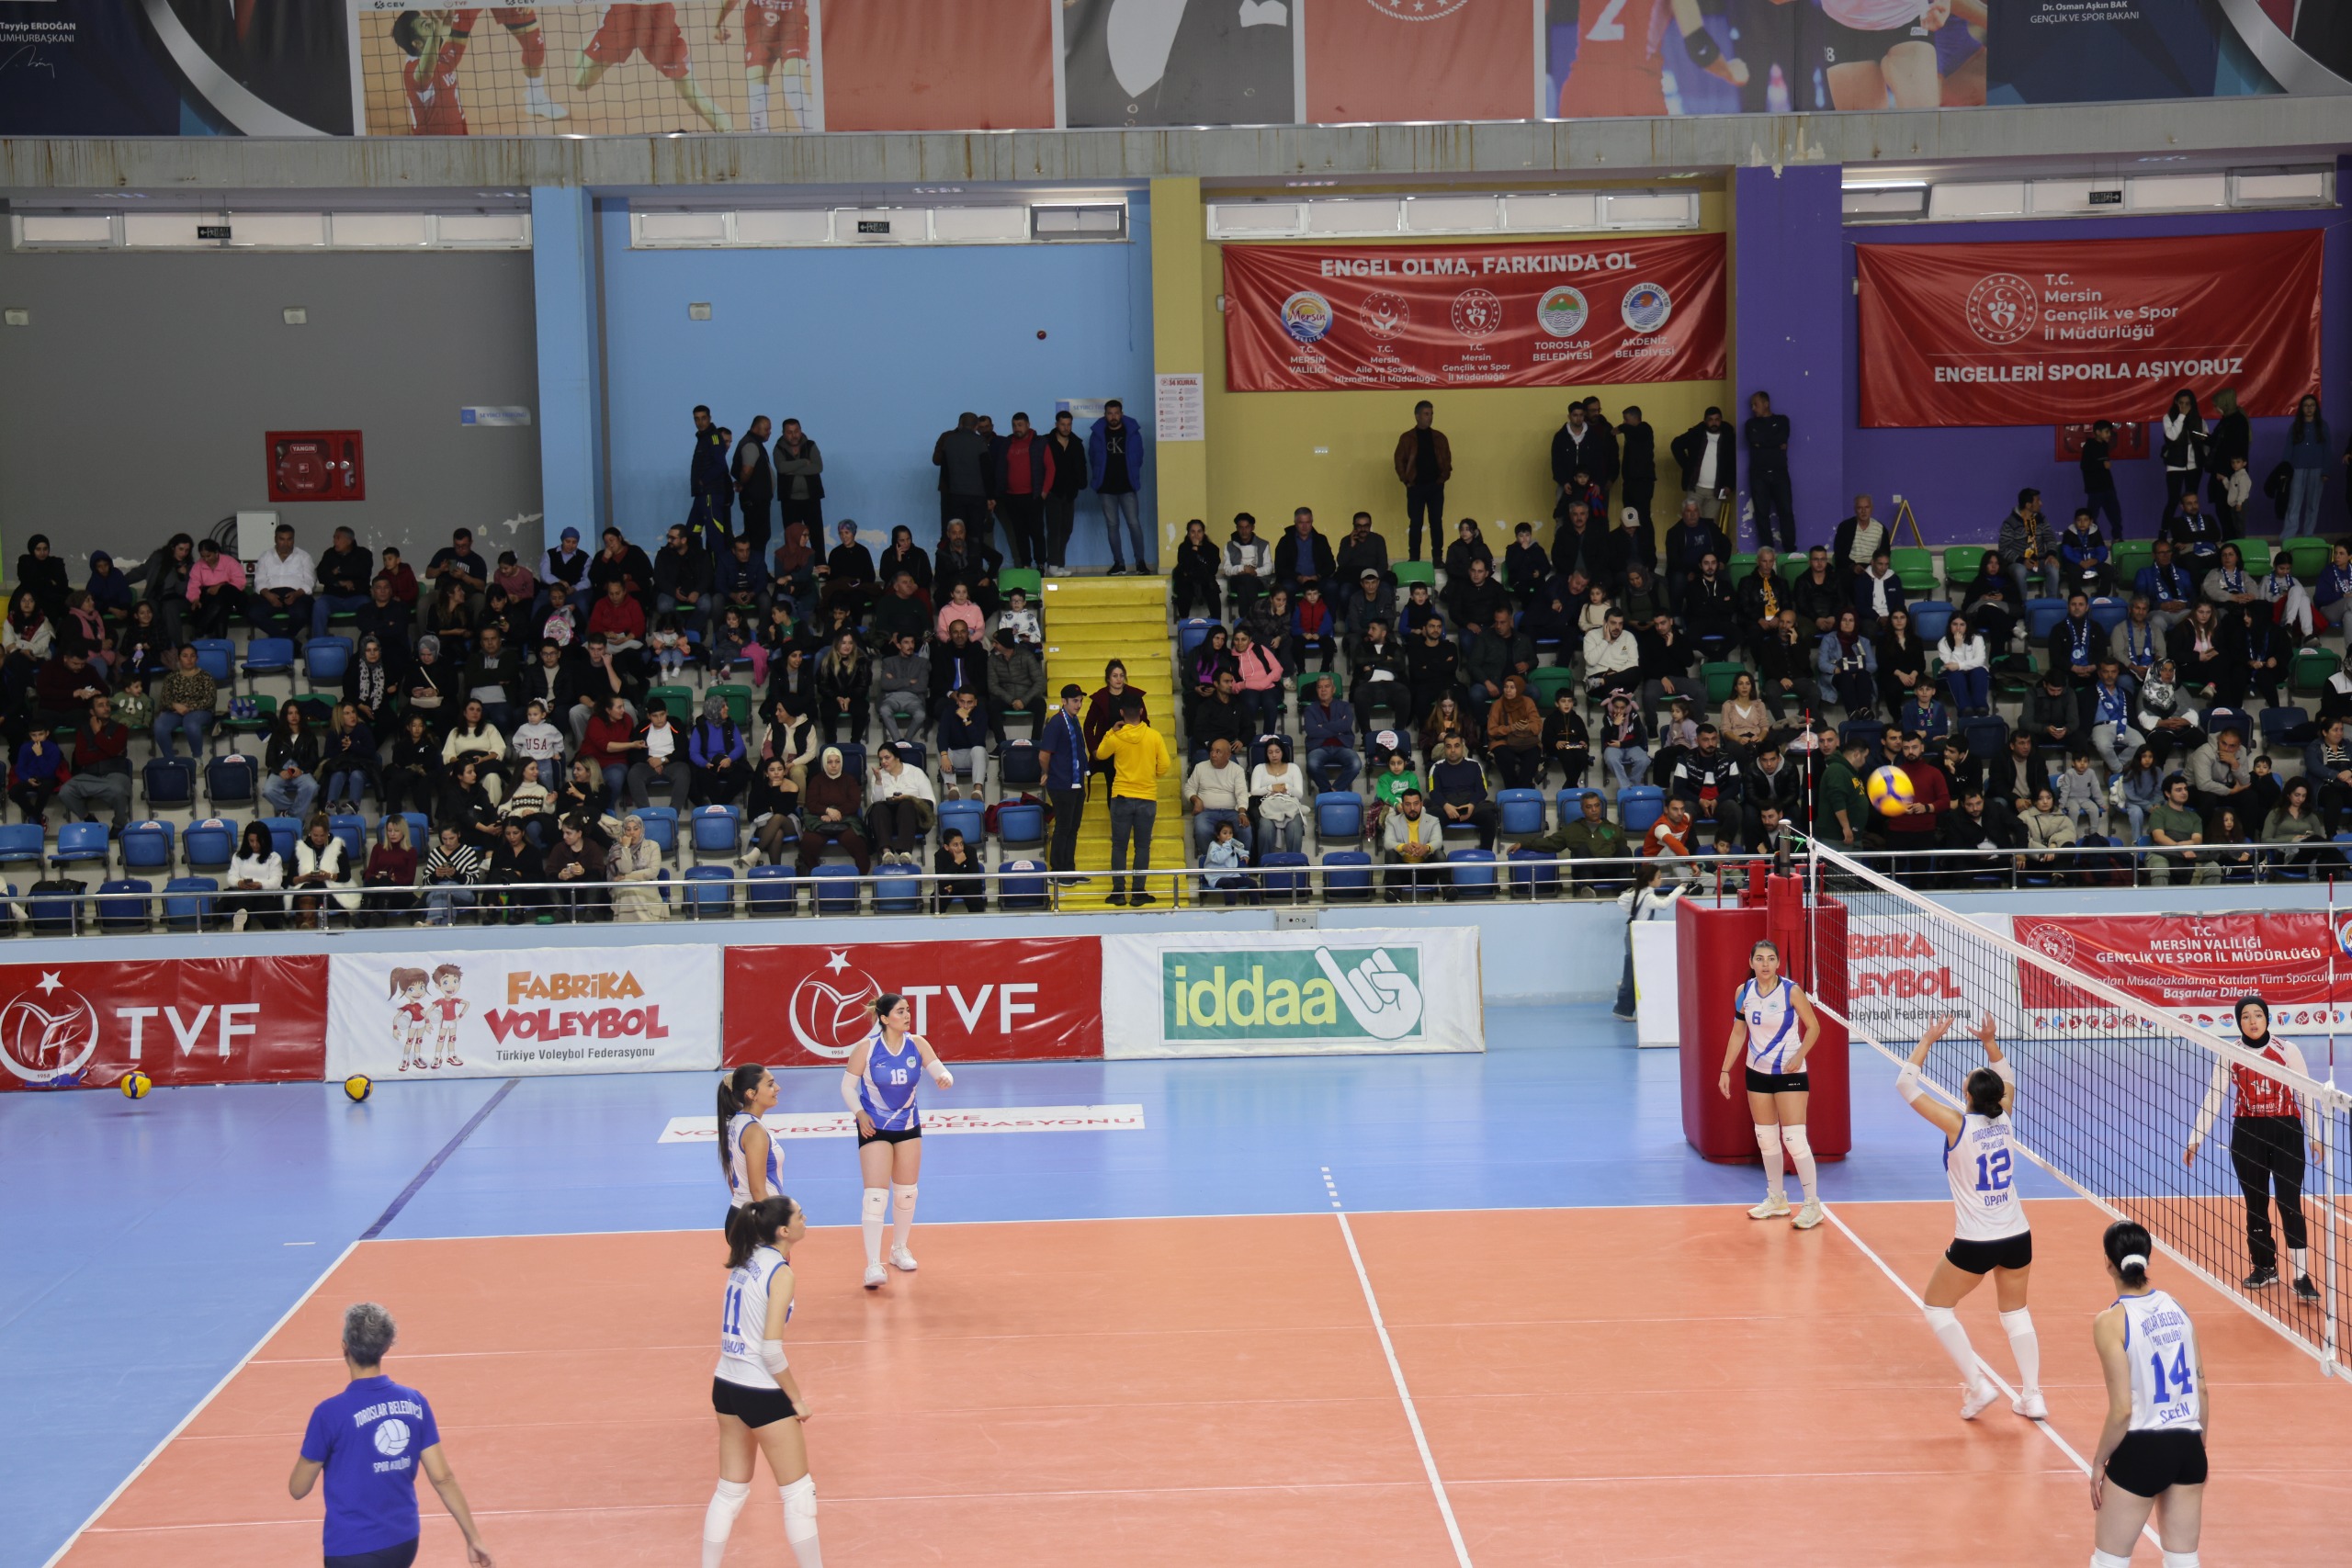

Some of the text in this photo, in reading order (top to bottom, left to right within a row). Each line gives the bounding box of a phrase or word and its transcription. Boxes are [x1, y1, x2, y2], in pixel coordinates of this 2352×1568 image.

[2042, 3, 2054, 11] Dr.
[2056, 2, 2084, 11] Osman
[2030, 11, 2140, 24] GENÇLİK VE SPOR BAKANI
[0, 21, 76, 31] Tayyip ERDOĞAN
[1321, 253, 1637, 277] ENGEL OLMA, FARKINDA OL
[2044, 274, 2075, 286] T.C.
[2044, 289, 2102, 303] Mersin
[2044, 305, 2179, 324] Gençlik ve Spor
[2044, 324, 2154, 342] İl Müdürlüğü
[1469, 344, 1485, 352] T.C.
[1534, 340, 1590, 350] TOROSLAR
[1622, 335, 1668, 347] AKDENİZ
[1299, 345, 1316, 354] T.C.
[1376, 345, 1394, 354] T.C.
[1532, 351, 1593, 361] BELEDİYESİ
[1614, 346, 1676, 359] BELEDİYESİ
[1290, 355, 1326, 364] MERSİN
[1370, 355, 1400, 364] Mersin
[1461, 353, 1491, 361] Mersin
[1355, 366, 1373, 374] Aile
[1386, 366, 1415, 376] Sosyal
[1442, 363, 1476, 373] Gençlik
[1490, 363, 1510, 372] Spor
[1934, 357, 2244, 383] ENGELLERİ SPORLA AŞIYORUZ
[1334, 375, 1379, 383] Hizmetler
[1387, 373, 1437, 384] Müdürlüğü
[1456, 371, 1505, 382] Müdürlüğü
[526, 738, 548, 750] USA
[2191, 926, 2216, 937] T.C.
[2150, 935, 2261, 951] MERSİN VALİLİĞİ
[2096, 947, 2322, 965] GENÇLİK VE SPOR İL MÜDÜRLÜĞÜ
[1848, 966, 1962, 1000] LEYBOL
[2127, 974, 2216, 987] Müsabakalarına
[2219, 973, 2257, 985] Katılan
[2261, 972, 2284, 984] Tüm
[1174, 964, 1337, 1027] iddaa
[2163, 985, 2262, 1001] Başarılar Dileriz.
[902, 983, 1039, 1035] TVF
[1849, 1008, 1891, 1022] oleybol
[483, 1004, 669, 1045] VOLEYBOL
[1751, 1010, 1762, 1025] 6
[116, 1002, 260, 1059] TVF
[496, 1046, 655, 1063] Türkiye Voleybol Federasyonu
[890, 1068, 908, 1085] 16
[2250, 1078, 2271, 1096] 14
[921, 1117, 1136, 1129] DERASYONU
[1975, 1147, 2013, 1191] 12
[723, 1285, 742, 1337] 11
[2151, 1341, 2193, 1404] 14
